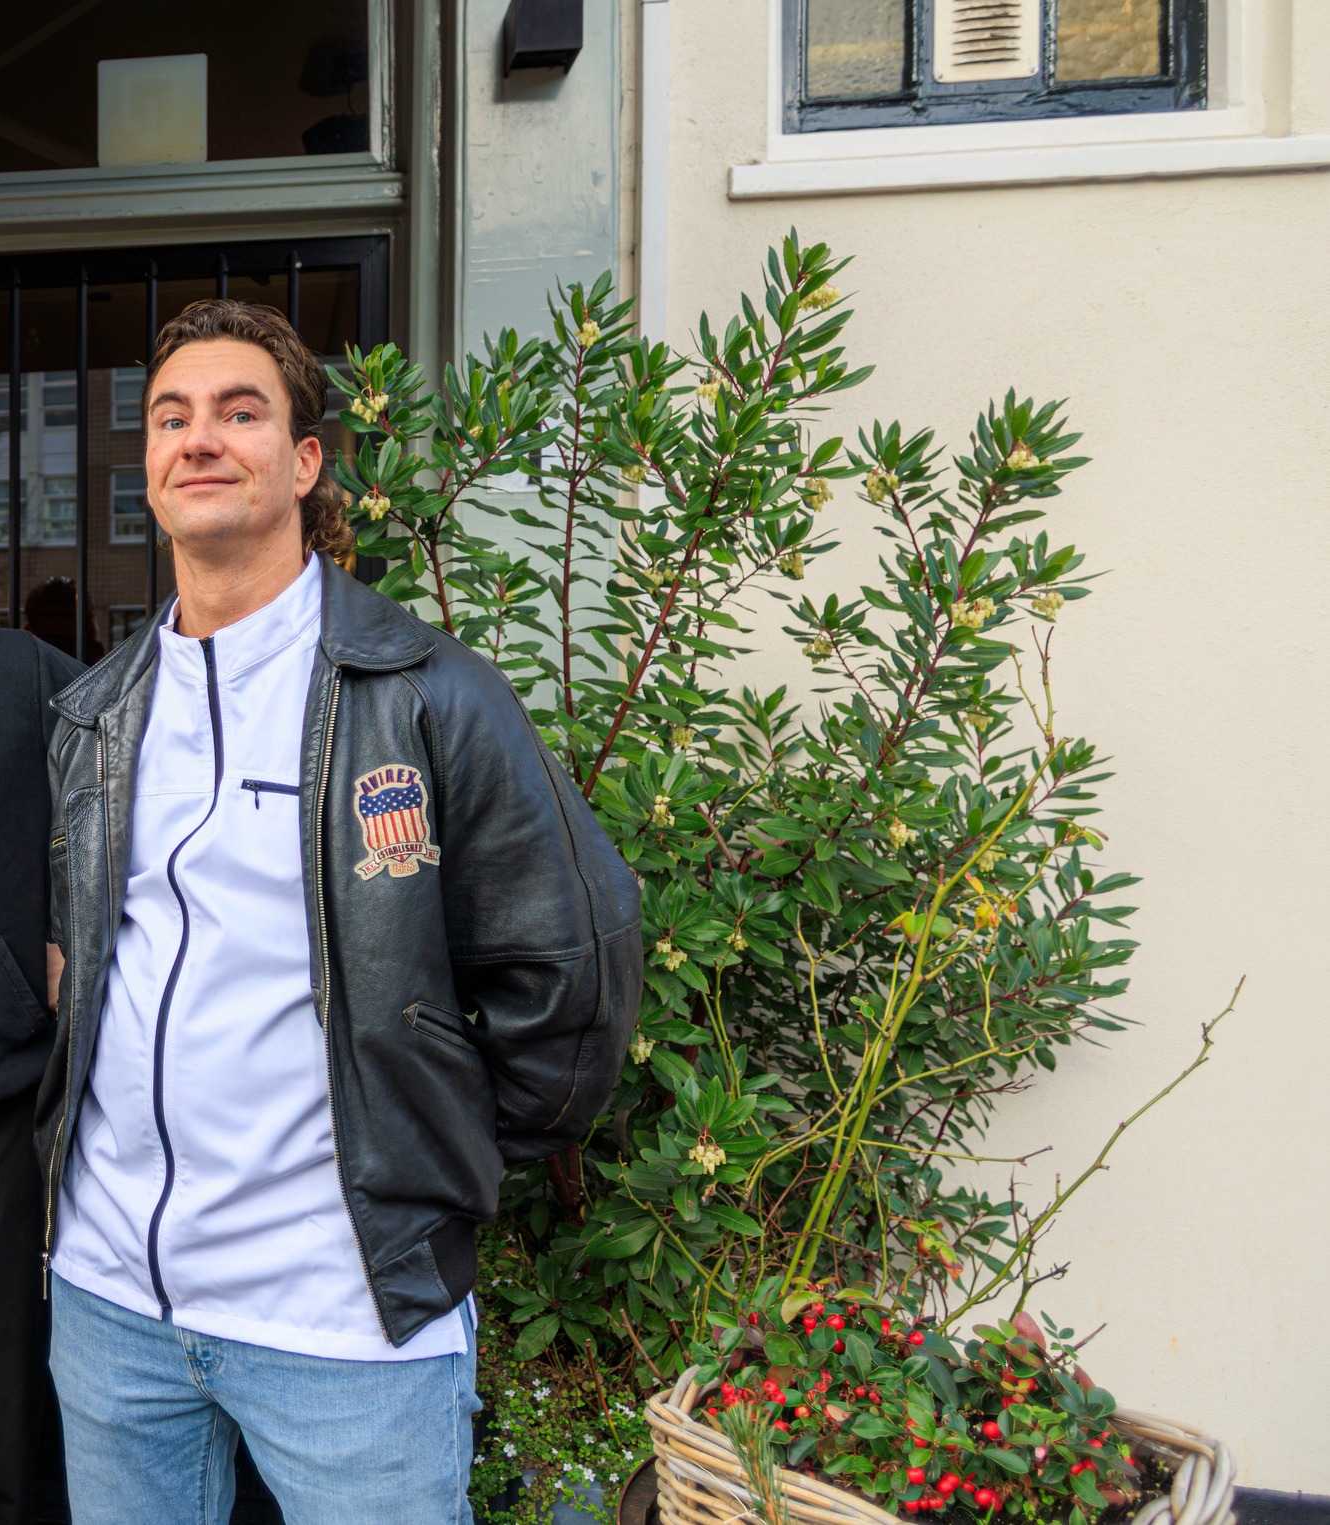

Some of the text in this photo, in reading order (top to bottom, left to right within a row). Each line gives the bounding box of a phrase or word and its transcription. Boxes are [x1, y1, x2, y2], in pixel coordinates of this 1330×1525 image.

[360, 768, 418, 795] AVIREX
[376, 843, 423, 860] ESTABLISHED
[391, 861, 415, 875] 1975
